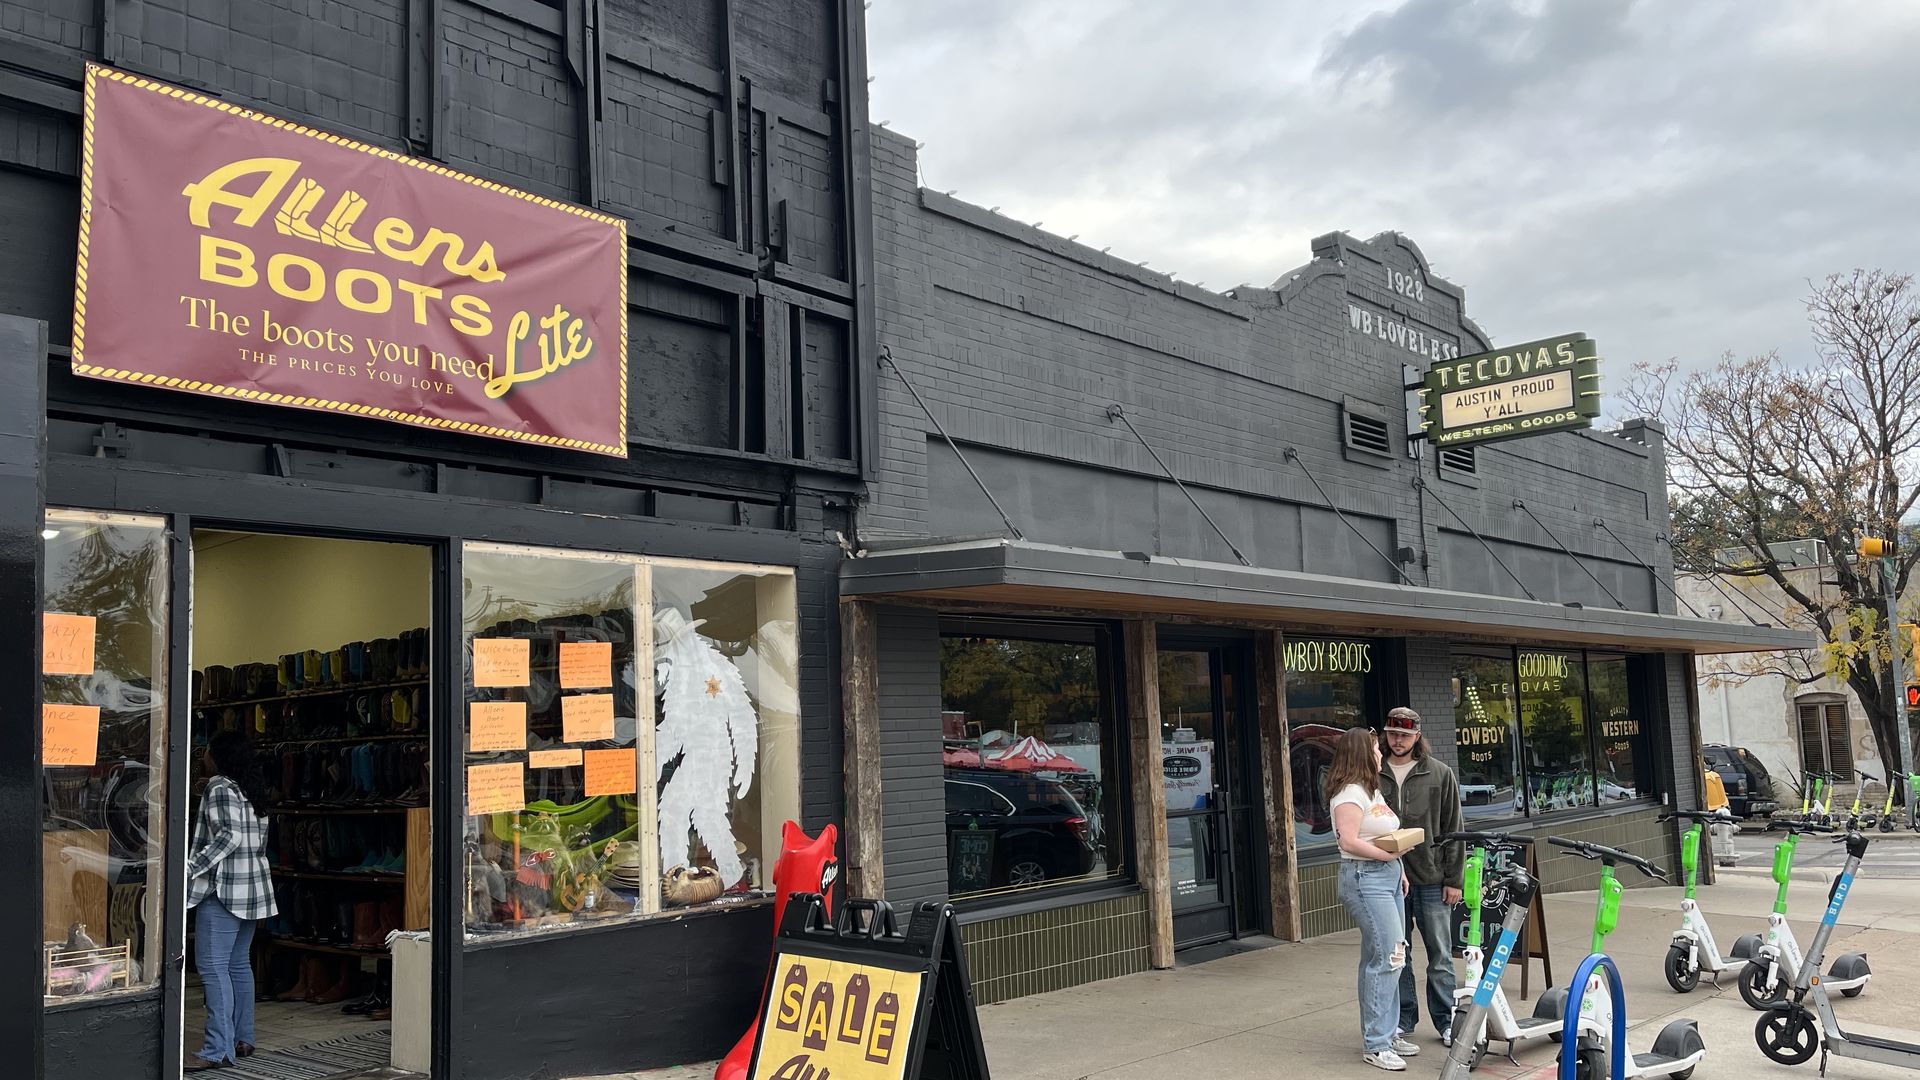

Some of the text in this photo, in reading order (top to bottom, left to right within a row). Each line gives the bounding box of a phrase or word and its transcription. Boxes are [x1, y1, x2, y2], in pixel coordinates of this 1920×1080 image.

[199, 233, 493, 337] BOOTS
[1386, 267, 1424, 302] 1928
[180, 295, 494, 381] The boots you need
[1348, 304, 1458, 360] WB LOVELESS
[484, 303, 593, 399] Lite
[1435, 342, 1576, 389] TECOVAS
[238, 348, 454, 395] THE PRICES YOU LOVE
[1456, 378, 1555, 409] AUSTIN PROUD
[1483, 401, 1523, 419] Y'ALL
[1439, 411, 1578, 442] WESTERN GOODS
[43, 624, 81, 647] razy
[1282, 641, 1371, 673] WBOY BOOTS
[1601, 720, 1639, 737] WESTERN
[1471, 750, 1492, 762] BOOTS
[1829, 882, 1848, 915] BIRD
[1483, 944, 1509, 991] BIRD
[779, 982, 896, 1058] SALE
